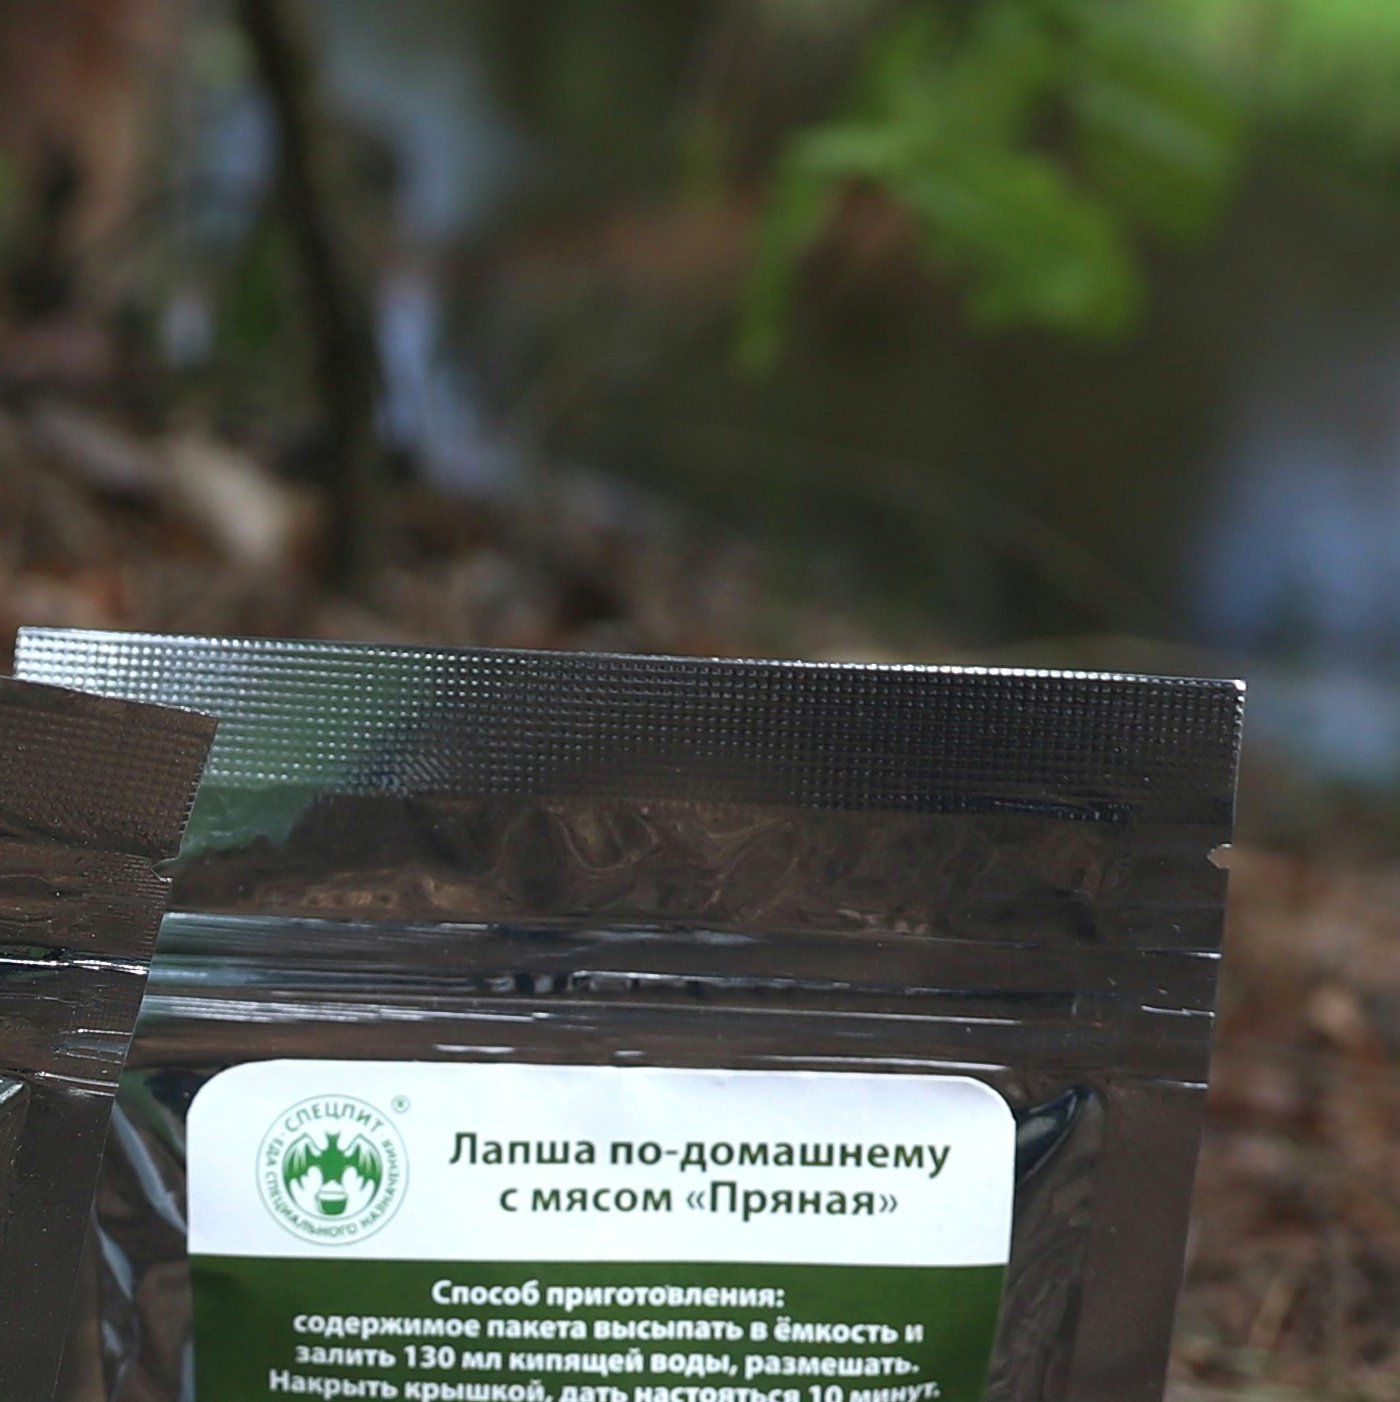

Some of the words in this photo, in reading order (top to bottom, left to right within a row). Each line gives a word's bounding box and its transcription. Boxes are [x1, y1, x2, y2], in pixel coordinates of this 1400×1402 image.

[284, 1101, 385, 1133] СПЕЦПИТ
[449, 1132, 596, 1165] Лапша
[610, 1141, 950, 1177] по-домашнему
[499, 1188, 517, 1212] с
[531, 1188, 672, 1212] мясом
[686, 1180, 898, 1223] «Пряная»
[431, 1279, 539, 1308] Способ
[547, 1282, 785, 1313] приготовления:
[293, 1313, 480, 1340] содержимое
[487, 1318, 588, 1341] пакета
[594, 1319, 742, 1342] высыпать
[749, 1322, 767, 1342] в
[773, 1316, 898, 1343] ёмкость
[904, 1322, 924, 1343] и
[295, 1344, 396, 1369] залить
[402, 1344, 455, 1370] 130
[462, 1349, 502, 1371] мл
[509, 1348, 643, 1377] кипящей
[650, 1352, 738, 1378] воды,
[744, 1354, 919, 1378] размешать.
[269, 1369, 398, 1401] Накрыть
